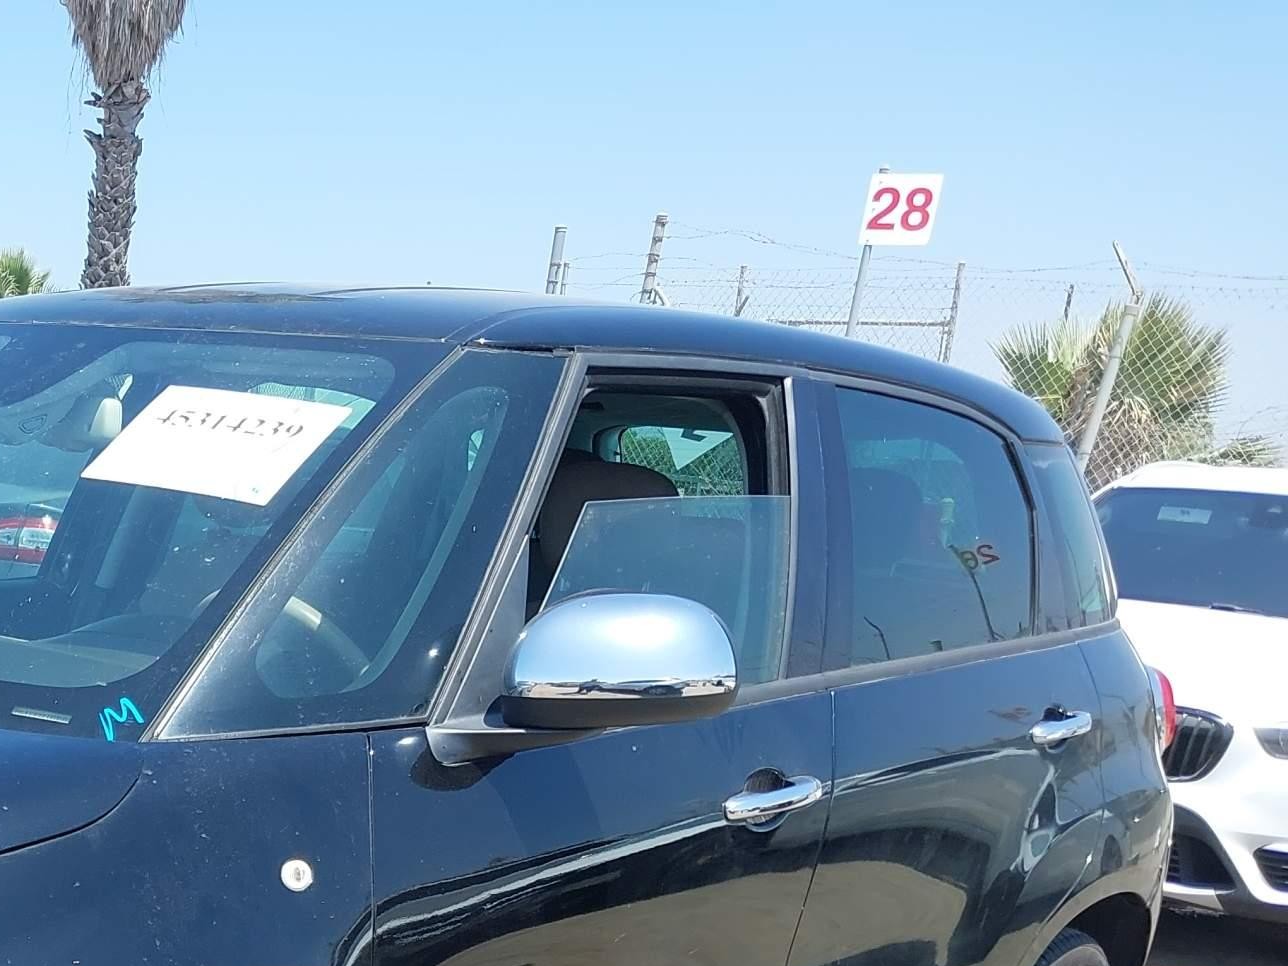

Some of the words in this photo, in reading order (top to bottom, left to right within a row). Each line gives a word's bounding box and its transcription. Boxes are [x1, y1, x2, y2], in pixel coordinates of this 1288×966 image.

[866, 187, 933, 231] 28
[156, 409, 304, 438] 45314239
[99, 697, 144, 741] M
